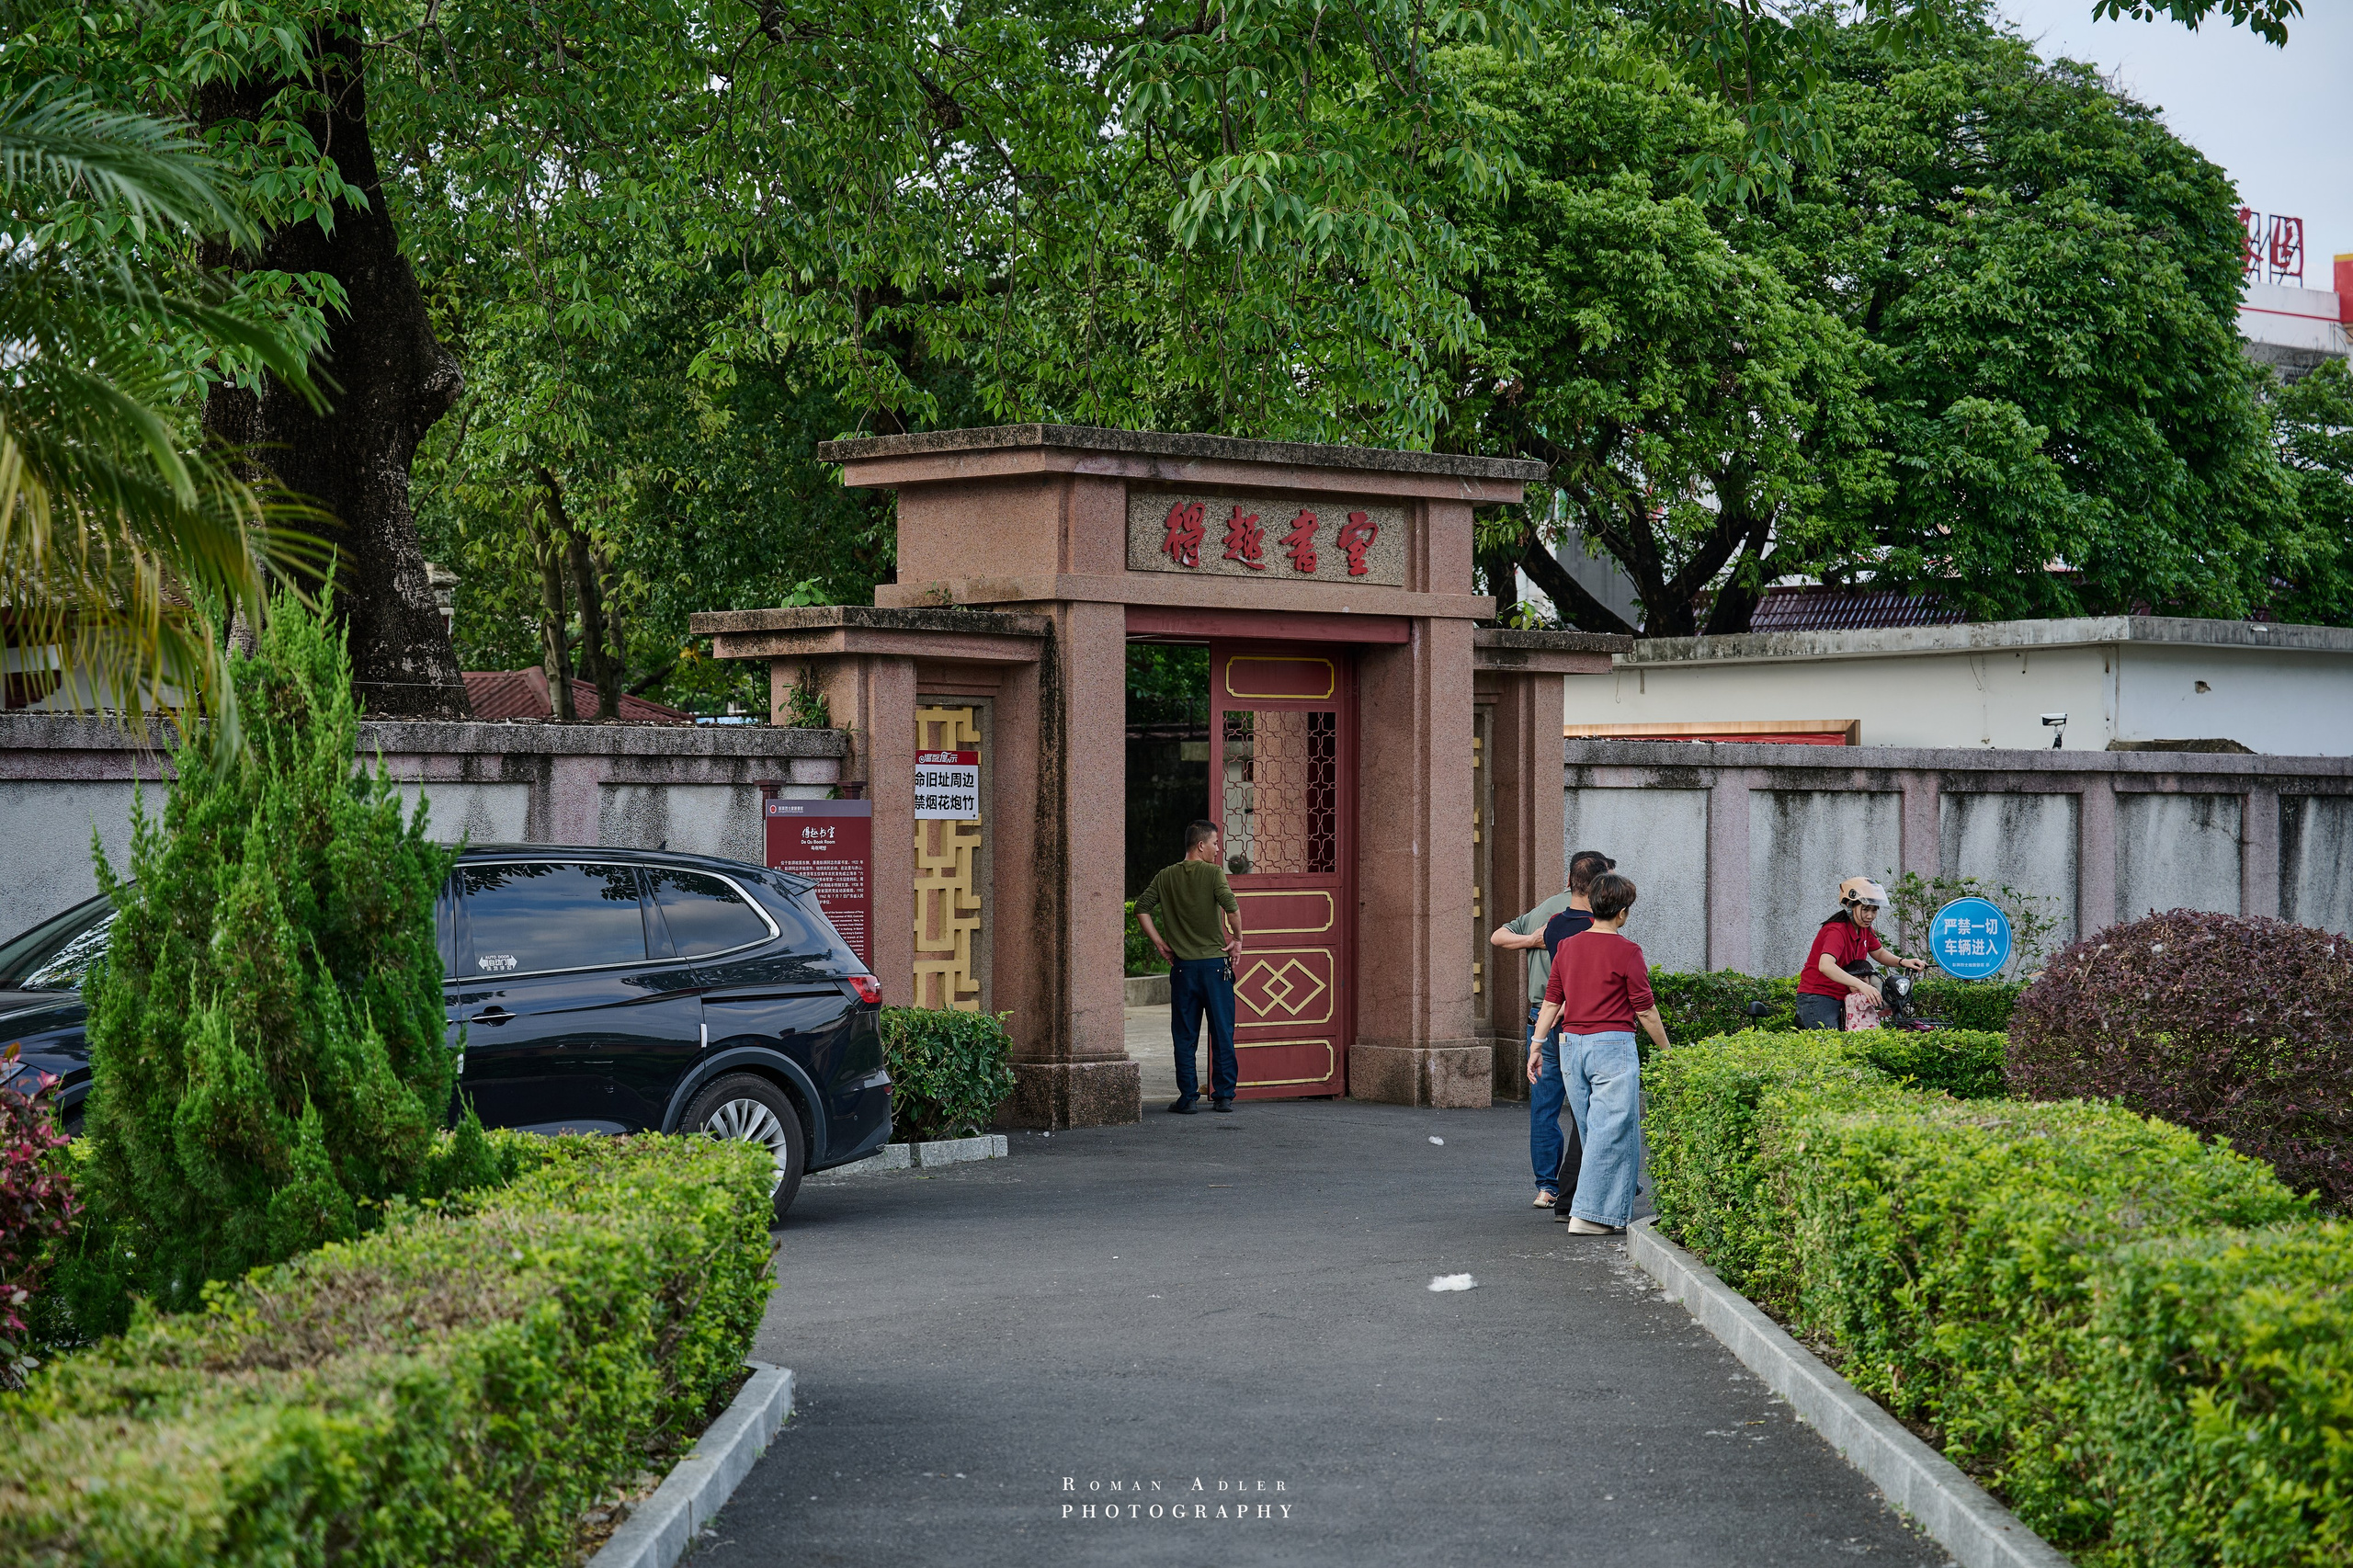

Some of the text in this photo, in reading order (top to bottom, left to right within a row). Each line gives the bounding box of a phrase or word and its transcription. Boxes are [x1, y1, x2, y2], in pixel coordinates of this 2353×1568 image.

[915, 771, 974, 788] 命旧址周边
[915, 794, 974, 811] 禁烟花炮竹
[1944, 918, 1998, 935] 严禁一切
[1944, 938, 1998, 956] 车辆进入
